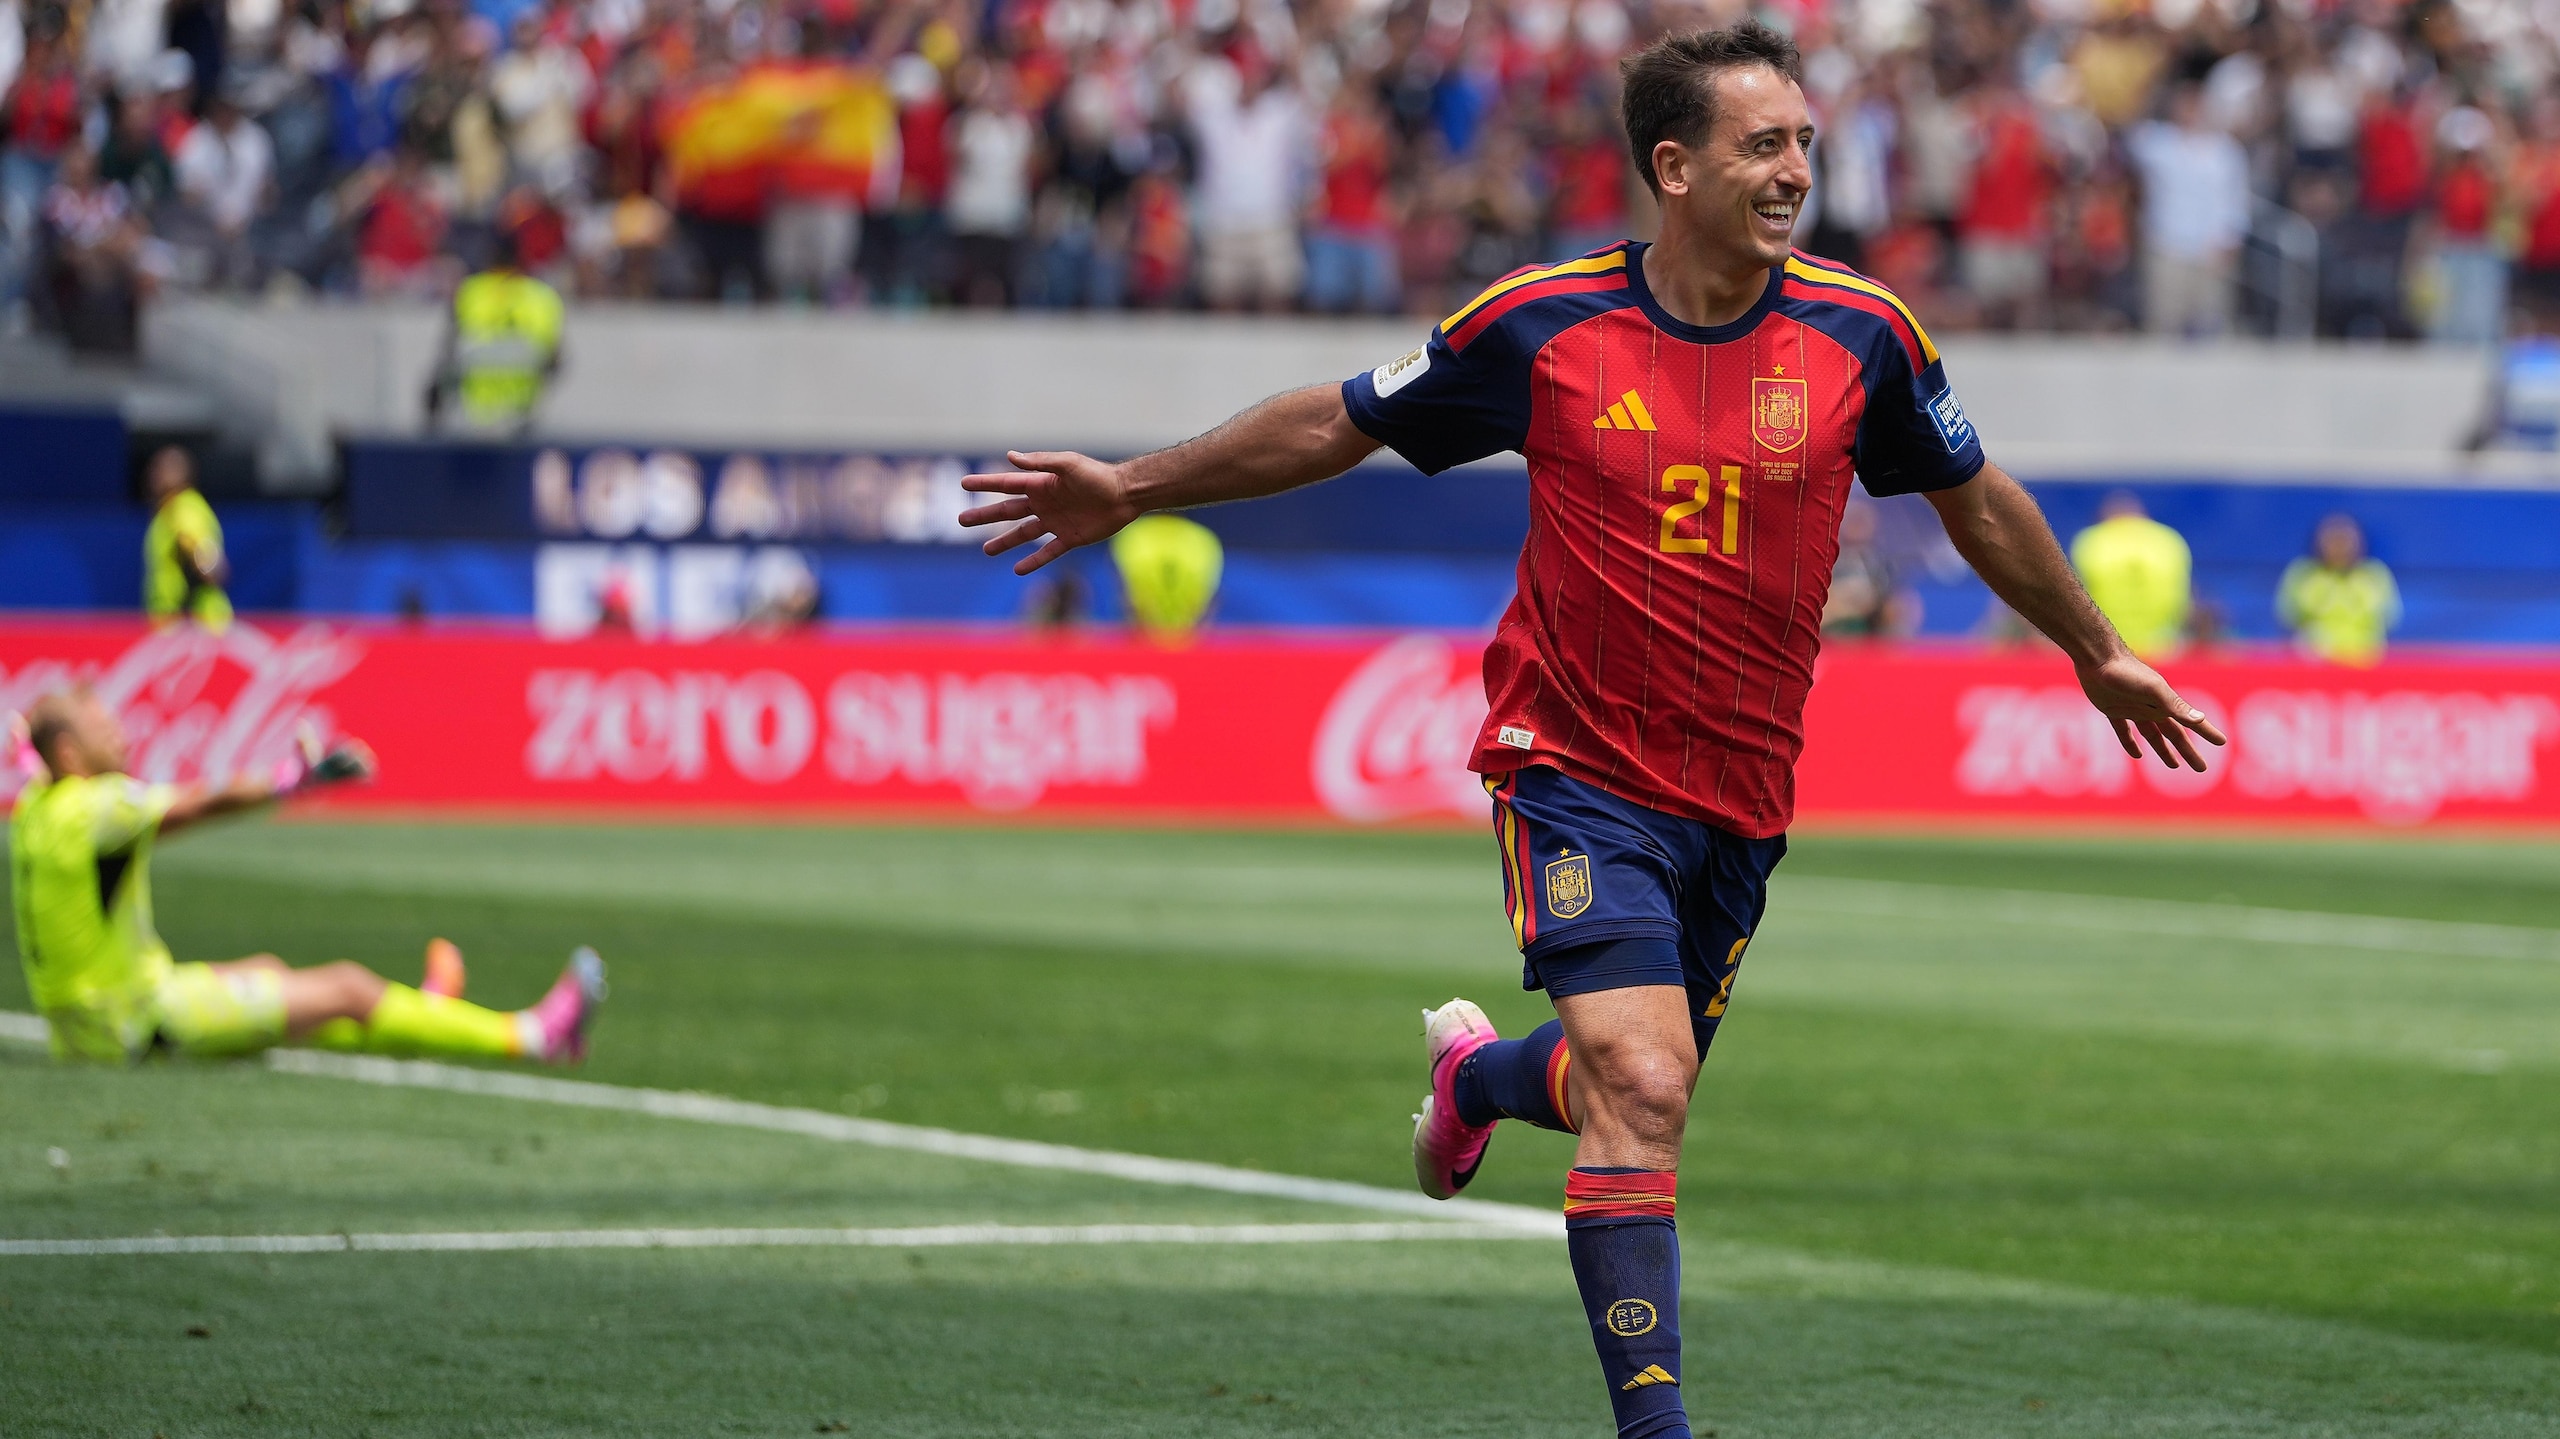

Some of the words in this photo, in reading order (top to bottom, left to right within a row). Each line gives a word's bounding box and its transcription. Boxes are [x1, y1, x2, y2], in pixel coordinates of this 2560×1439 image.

[1659, 464, 1742, 555] 21
[524, 667, 817, 785] zero
[823, 668, 1179, 812] sugar
[2231, 688, 2558, 825] sugar
